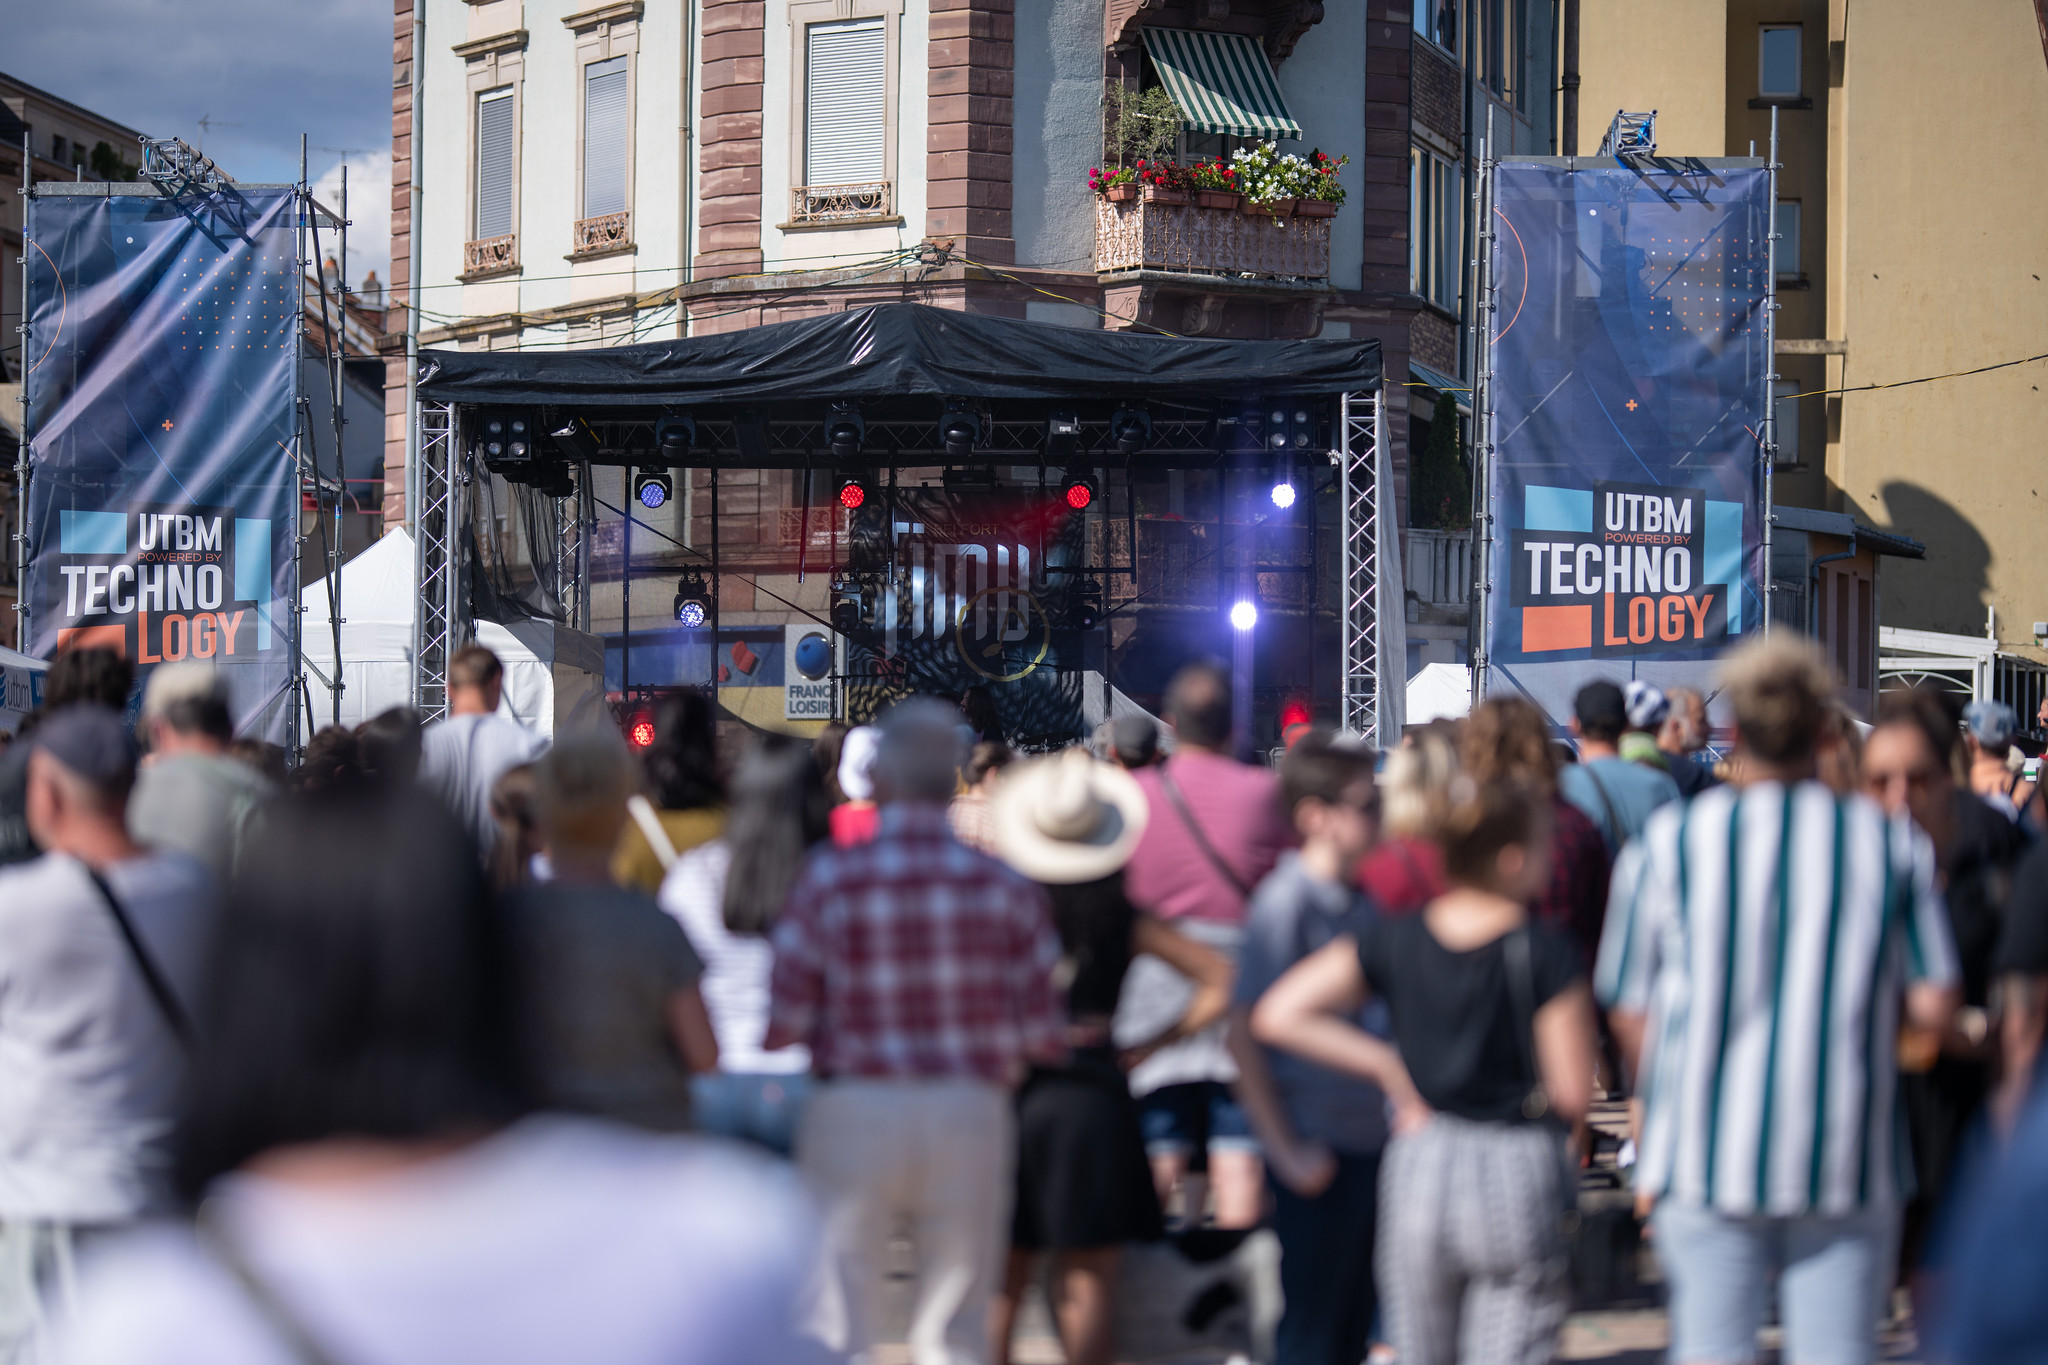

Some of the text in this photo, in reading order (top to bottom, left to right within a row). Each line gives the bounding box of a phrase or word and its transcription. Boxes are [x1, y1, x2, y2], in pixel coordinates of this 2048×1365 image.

[139, 513, 222, 551] UTBM
[1605, 492, 1692, 534] UTBM
[137, 552, 222, 562] POWERED BY
[1605, 532, 1691, 545] POWERED BY
[1523, 542, 1691, 595] TECHNO
[60, 564, 223, 617] TECHNO
[138, 611, 245, 664] LOGY
[1604, 592, 1715, 647] LOGY
[7, 674, 30, 710] utbm
[789, 685, 831, 698] FRANC
